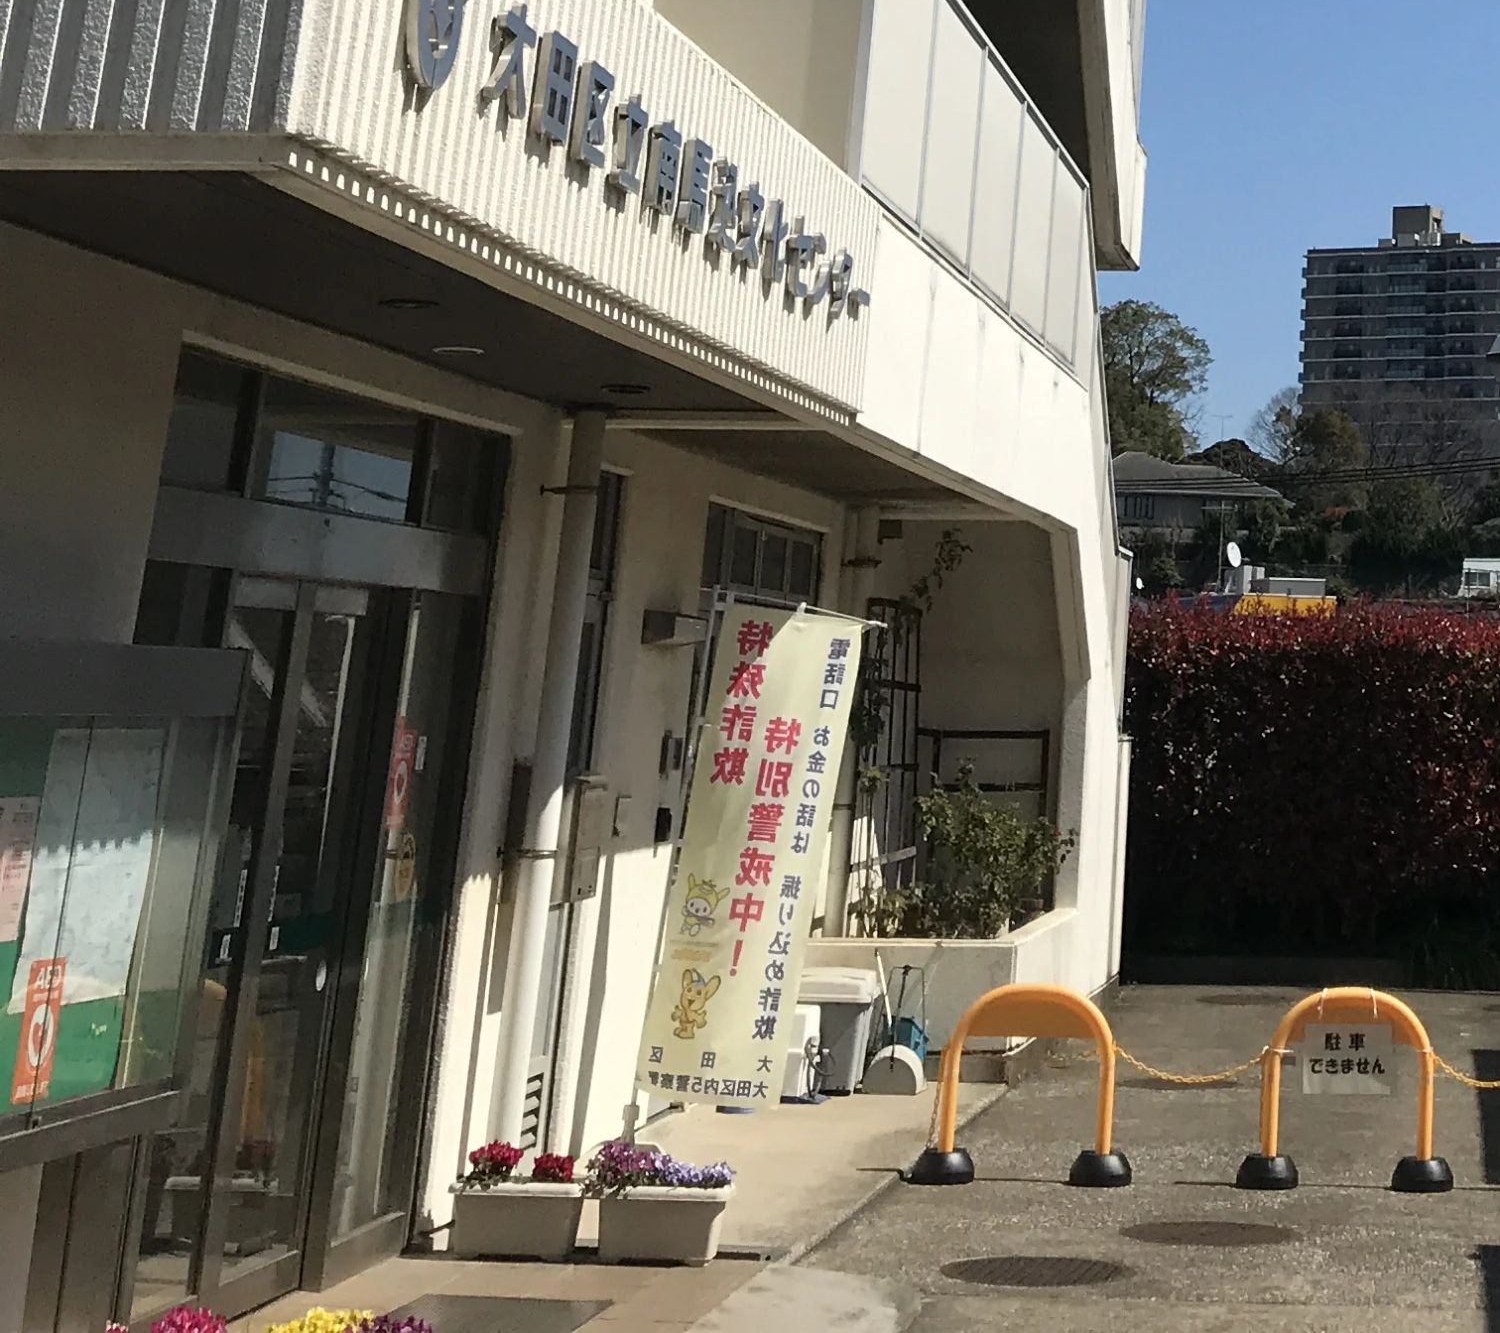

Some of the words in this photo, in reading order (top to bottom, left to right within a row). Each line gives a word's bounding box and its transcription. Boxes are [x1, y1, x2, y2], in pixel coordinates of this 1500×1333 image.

[1324, 1032, 1367, 1051] 駐車
[1309, 1057, 1386, 1075] できません
